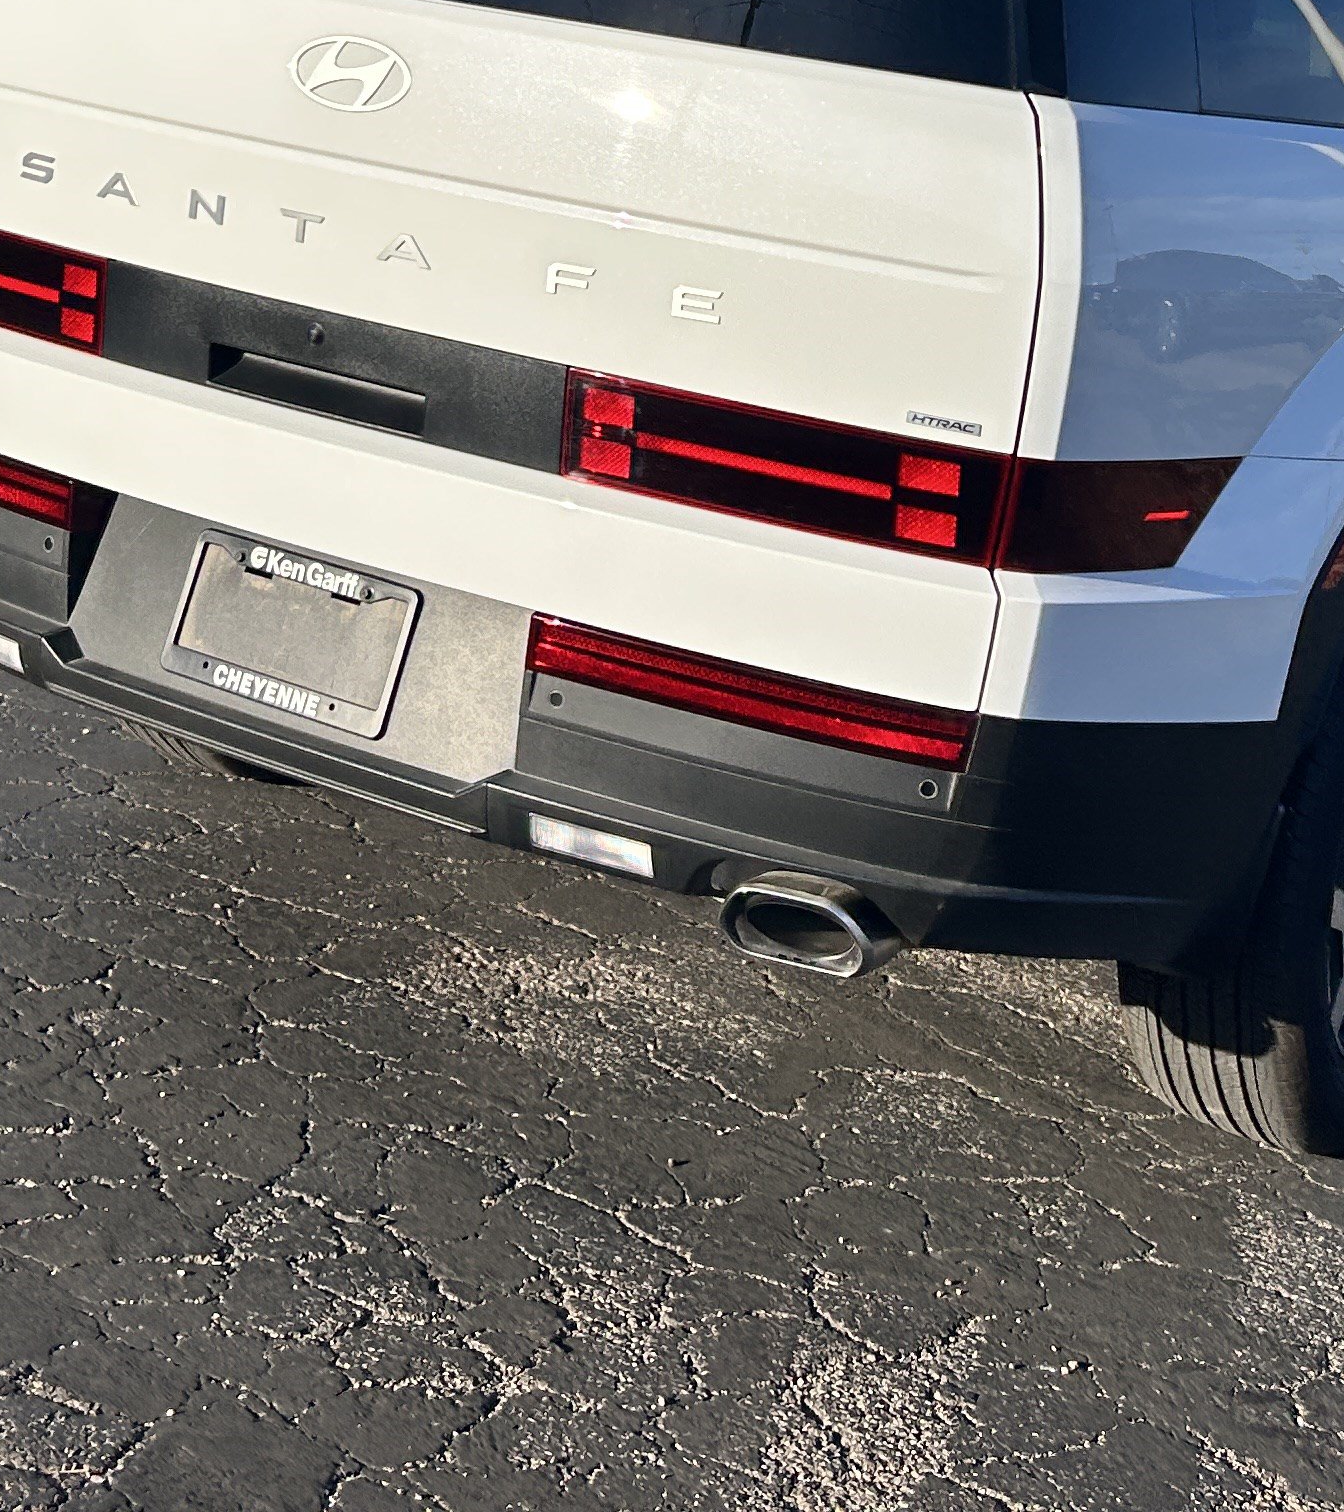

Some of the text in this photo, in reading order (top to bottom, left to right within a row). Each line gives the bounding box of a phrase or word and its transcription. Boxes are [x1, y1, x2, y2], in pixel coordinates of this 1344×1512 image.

[19, 151, 724, 326] SANTA FE
[911, 413, 976, 434] HTRAC
[267, 549, 360, 598] Ken Garff
[212, 663, 321, 718] CHEYENNE
